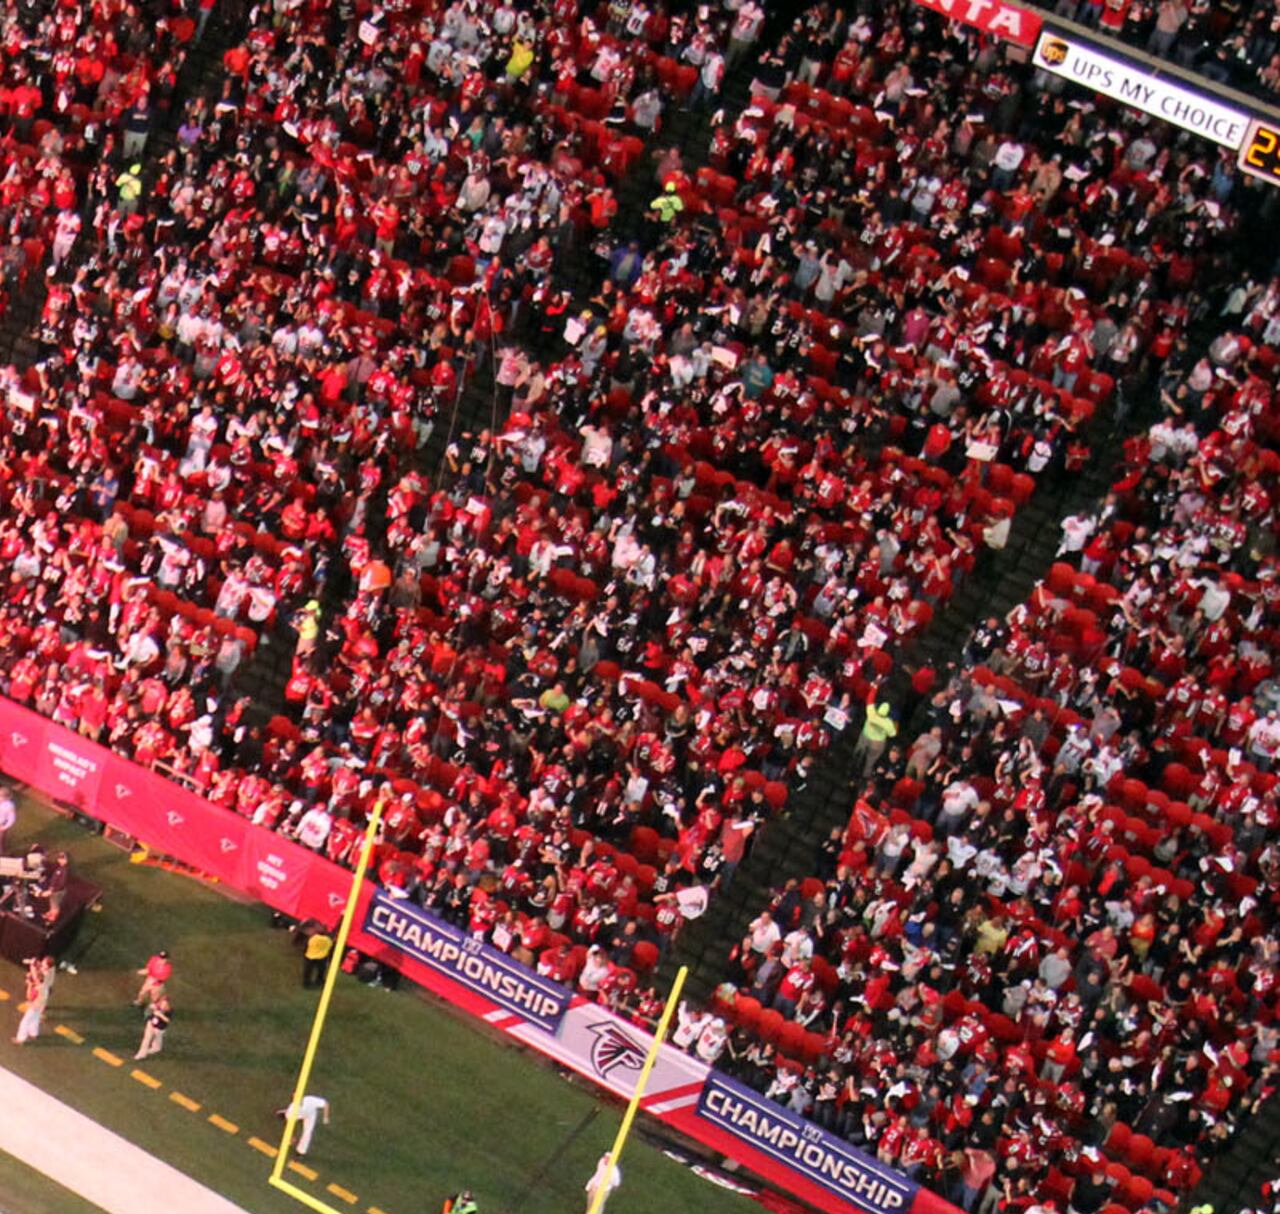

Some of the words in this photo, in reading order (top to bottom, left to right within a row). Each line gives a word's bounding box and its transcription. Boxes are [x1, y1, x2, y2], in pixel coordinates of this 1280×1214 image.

[1072, 57, 1113, 88] UPS
[1120, 79, 1155, 103] MY
[1160, 96, 1240, 142] CHOICE
[371, 904, 563, 1020] CHAMPIONSHIP
[703, 1088, 904, 1211] CHAMPIONSHIP
